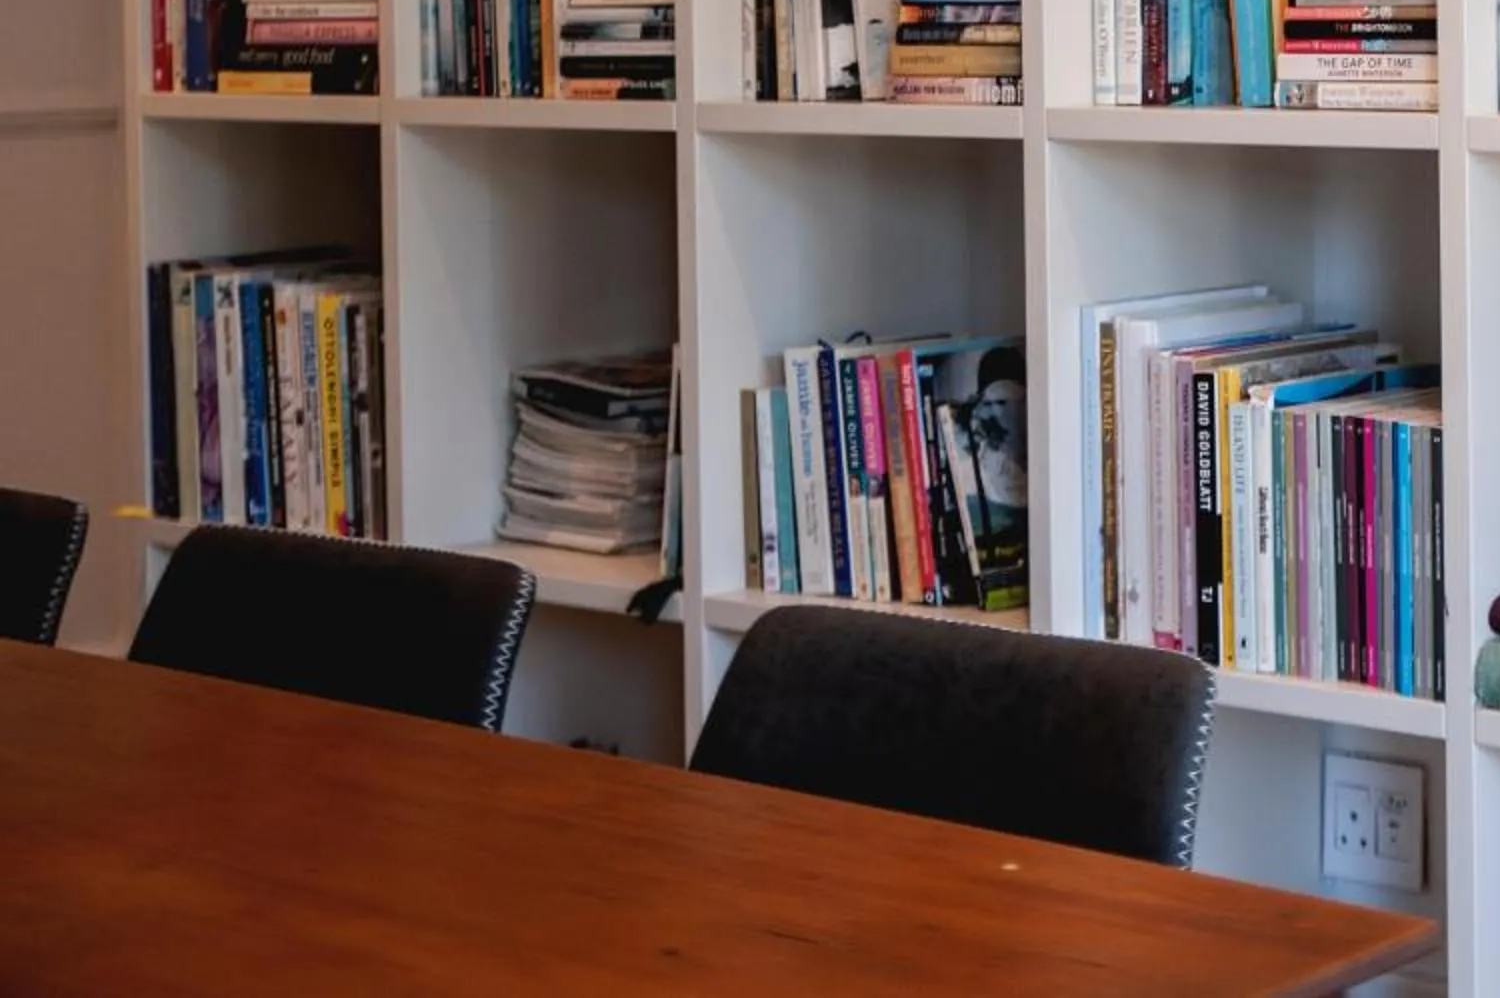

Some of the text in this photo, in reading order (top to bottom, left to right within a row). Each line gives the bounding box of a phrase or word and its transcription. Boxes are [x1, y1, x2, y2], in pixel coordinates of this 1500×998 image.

[1317, 57, 1414, 69] THE GAP OF TIME
[793, 359, 812, 417] jamie
[842, 377, 860, 469] JAMIE OLIVER
[863, 423, 877, 471] OLIVER
[1231, 414, 1246, 463] ISLAND
[1197, 381, 1213, 603] DAVID GOLDBLATT TJ
